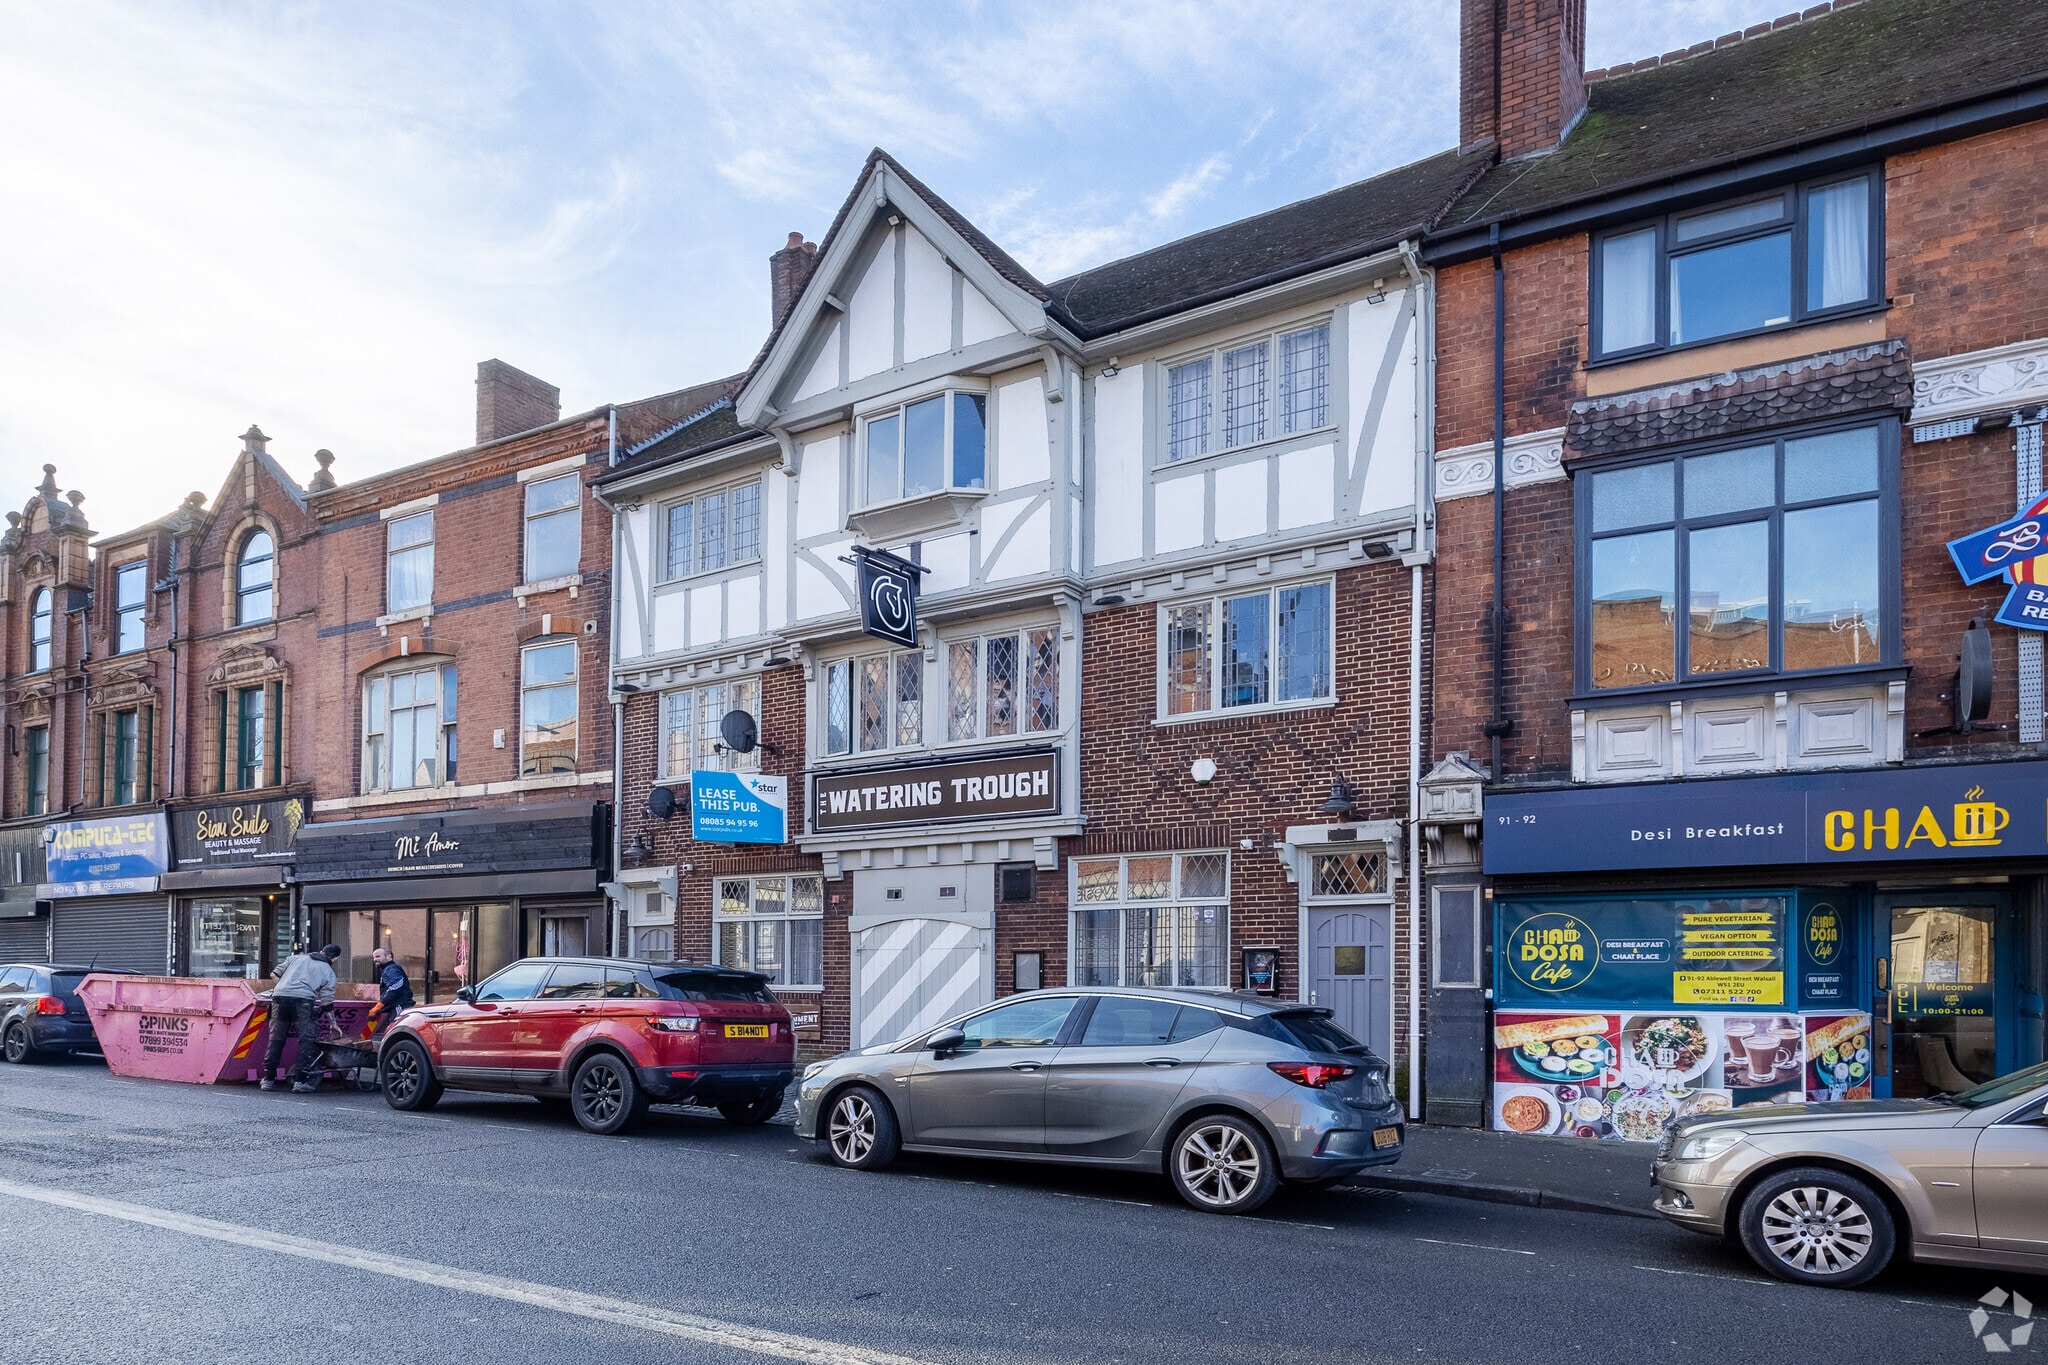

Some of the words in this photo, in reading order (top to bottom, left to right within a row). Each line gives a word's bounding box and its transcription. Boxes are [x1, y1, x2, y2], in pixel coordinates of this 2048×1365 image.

[699, 788, 736, 800] LEASE
[758, 784, 777, 793] star
[829, 781, 942, 814] WATERING
[951, 770, 1049, 803] TROUGH
[699, 799, 730, 811] THIS
[733, 801, 761, 813] PUB.
[196, 810, 228, 841] Siam
[230, 804, 270, 837] Smile
[700, 818, 725, 826] 08085
[737, 819, 747, 827] 95
[748, 820, 758, 828] 96
[1498, 816, 1510, 825] 91
[1522, 815, 1536, 824] 92
[55, 821, 155, 850] COMPUTA-TEC
[1631, 828, 1672, 841] Desi
[1685, 823, 1784, 839] Breakfast
[205, 839, 227, 848] BEAUTY
[234, 837, 262, 846] MASSAGE
[395, 835, 421, 860] Mi
[53, 886, 65, 894] NO
[76, 884, 88, 892] NO
[89, 883, 102, 891] FEE
[104, 881, 134, 889] REPAIRS
[1810, 928, 1838, 941] DOSA
[1521, 944, 1584, 961] DOSA
[1815, 941, 1832, 959] Cafe
[1531, 962, 1573, 984] Cafe
[1926, 983, 1974, 991] Welcome
[1897, 984, 1909, 1013] PULL
[150, 1015, 189, 1031] PINKS
